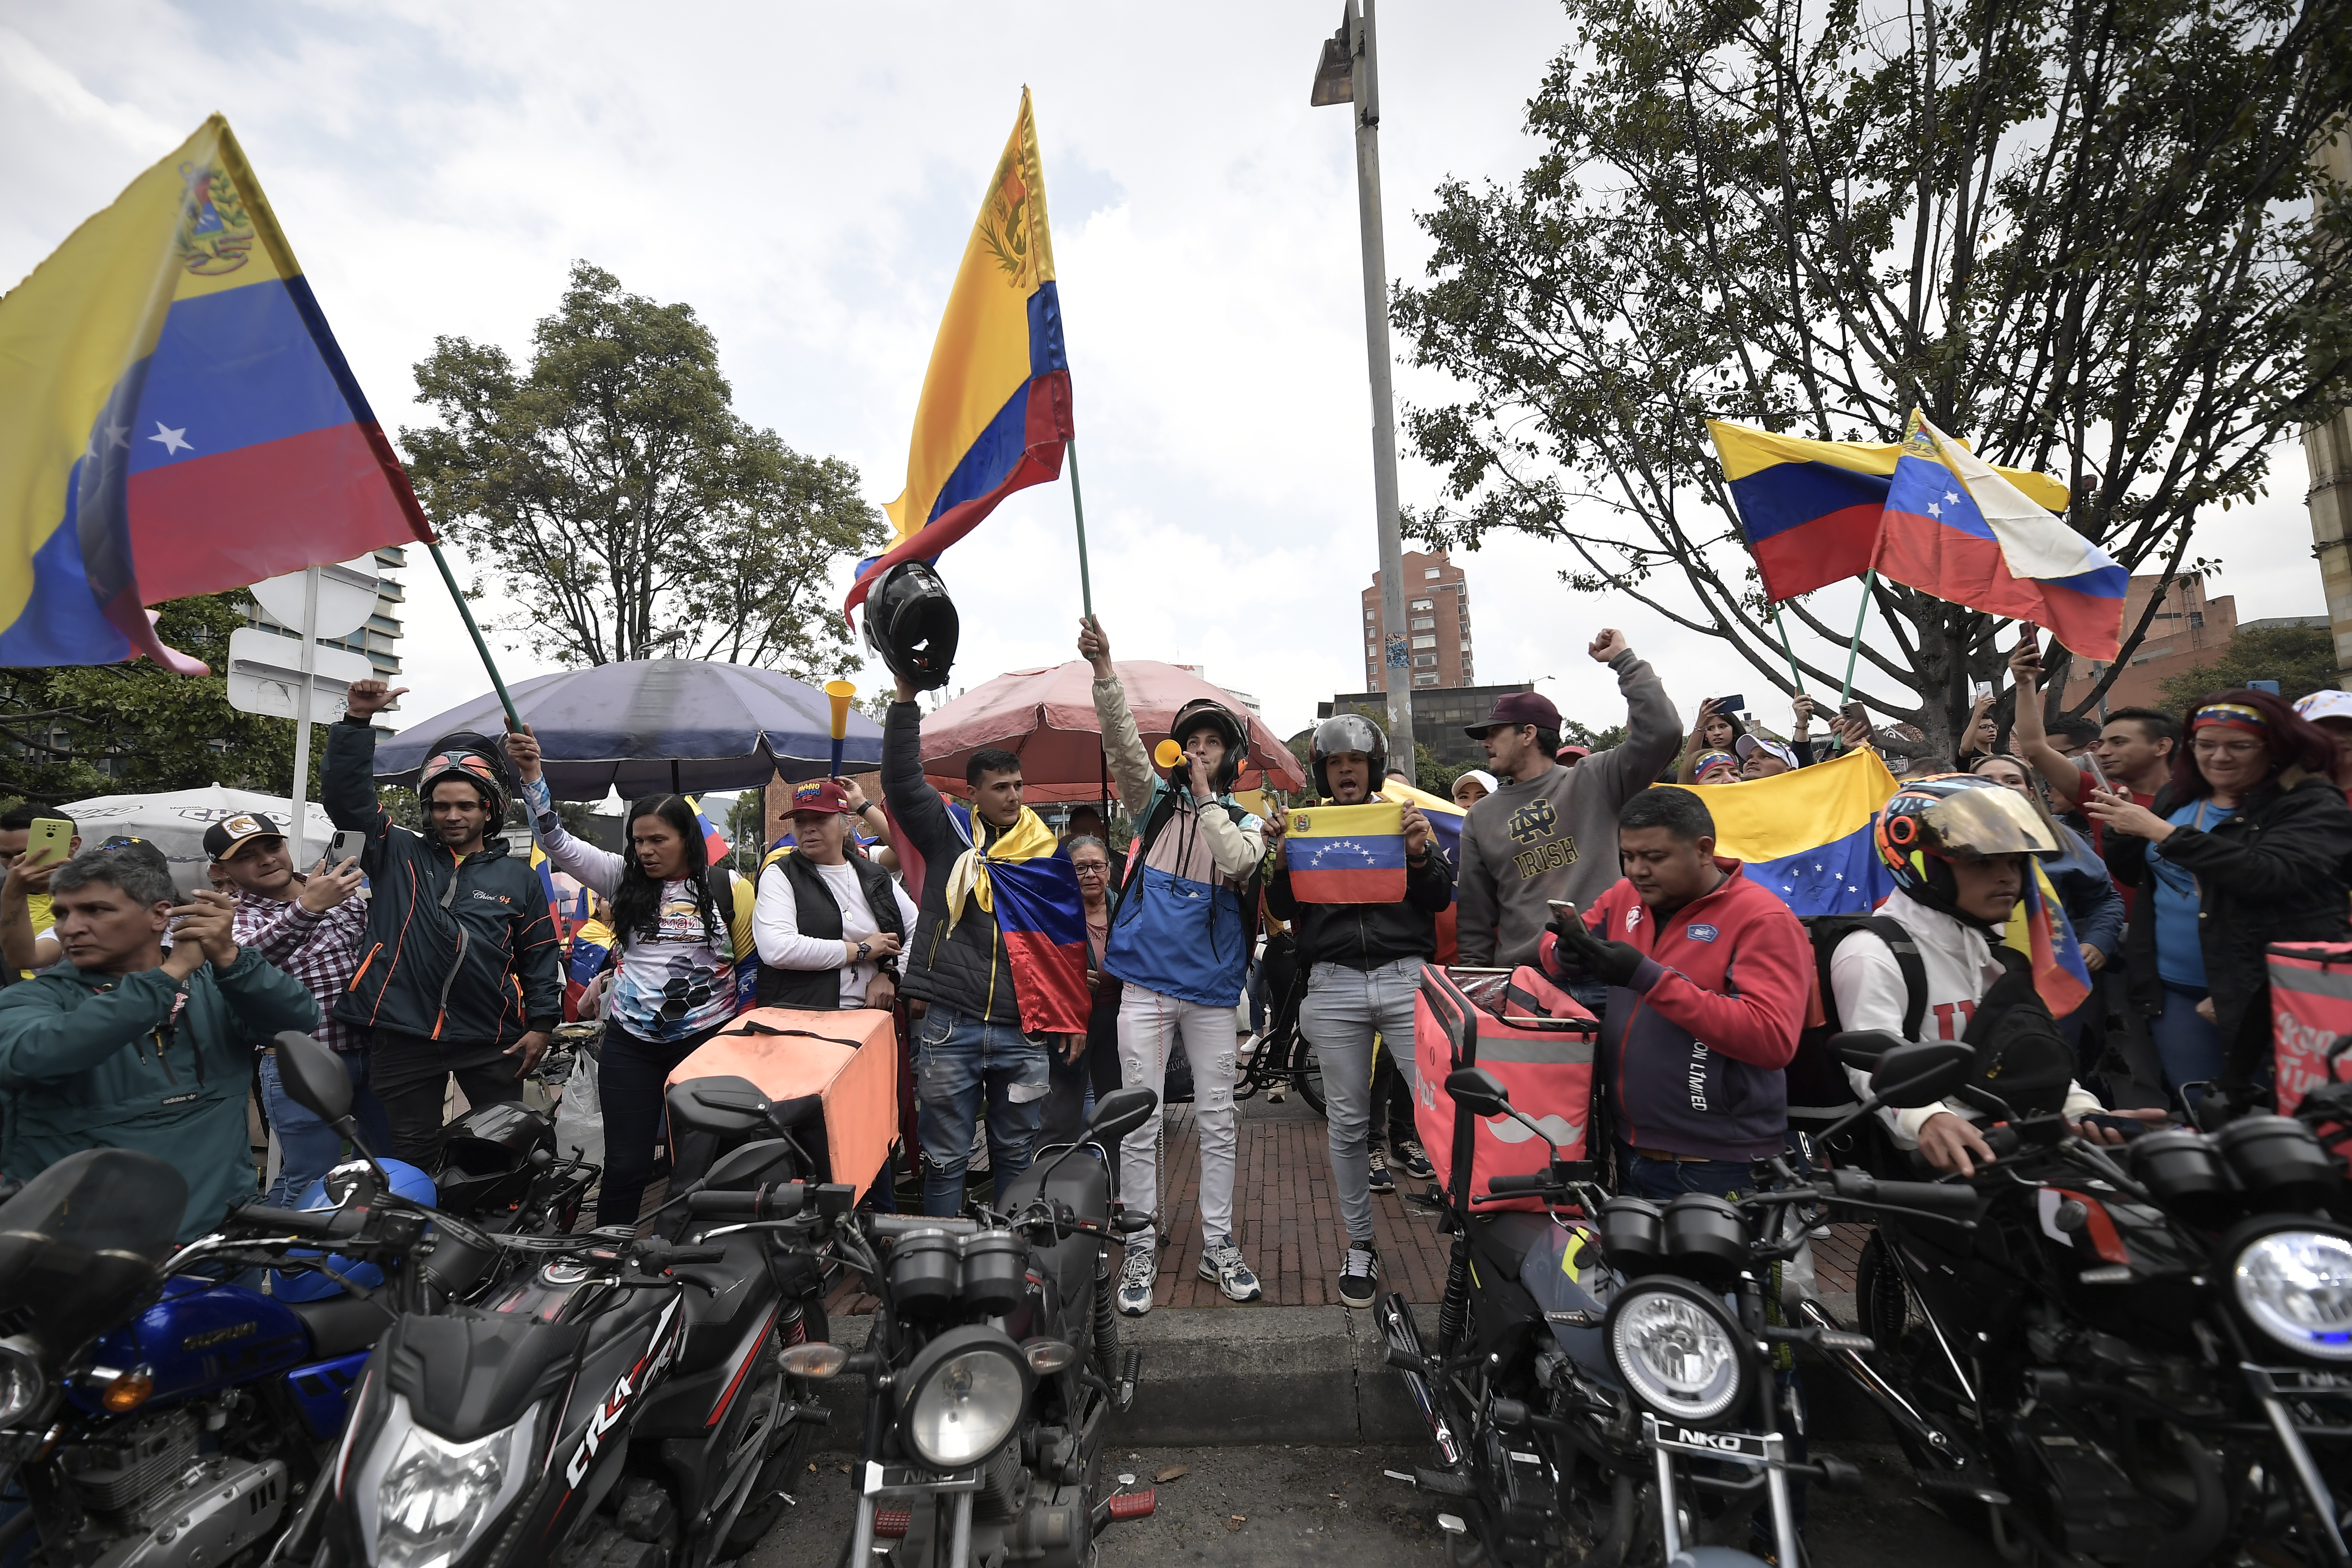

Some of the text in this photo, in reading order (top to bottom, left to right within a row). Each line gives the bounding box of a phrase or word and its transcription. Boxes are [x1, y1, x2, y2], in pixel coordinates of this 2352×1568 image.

[798, 783, 820, 792] MANO
[796, 789, 820, 799] TENGO
[1512, 836, 1580, 880] IRISH
[500, 896, 511, 904] 94
[1692, 1038, 1709, 1060] ON
[163, 1096, 186, 1104] adidas
[182, 1321, 257, 1352] SUZUKI
